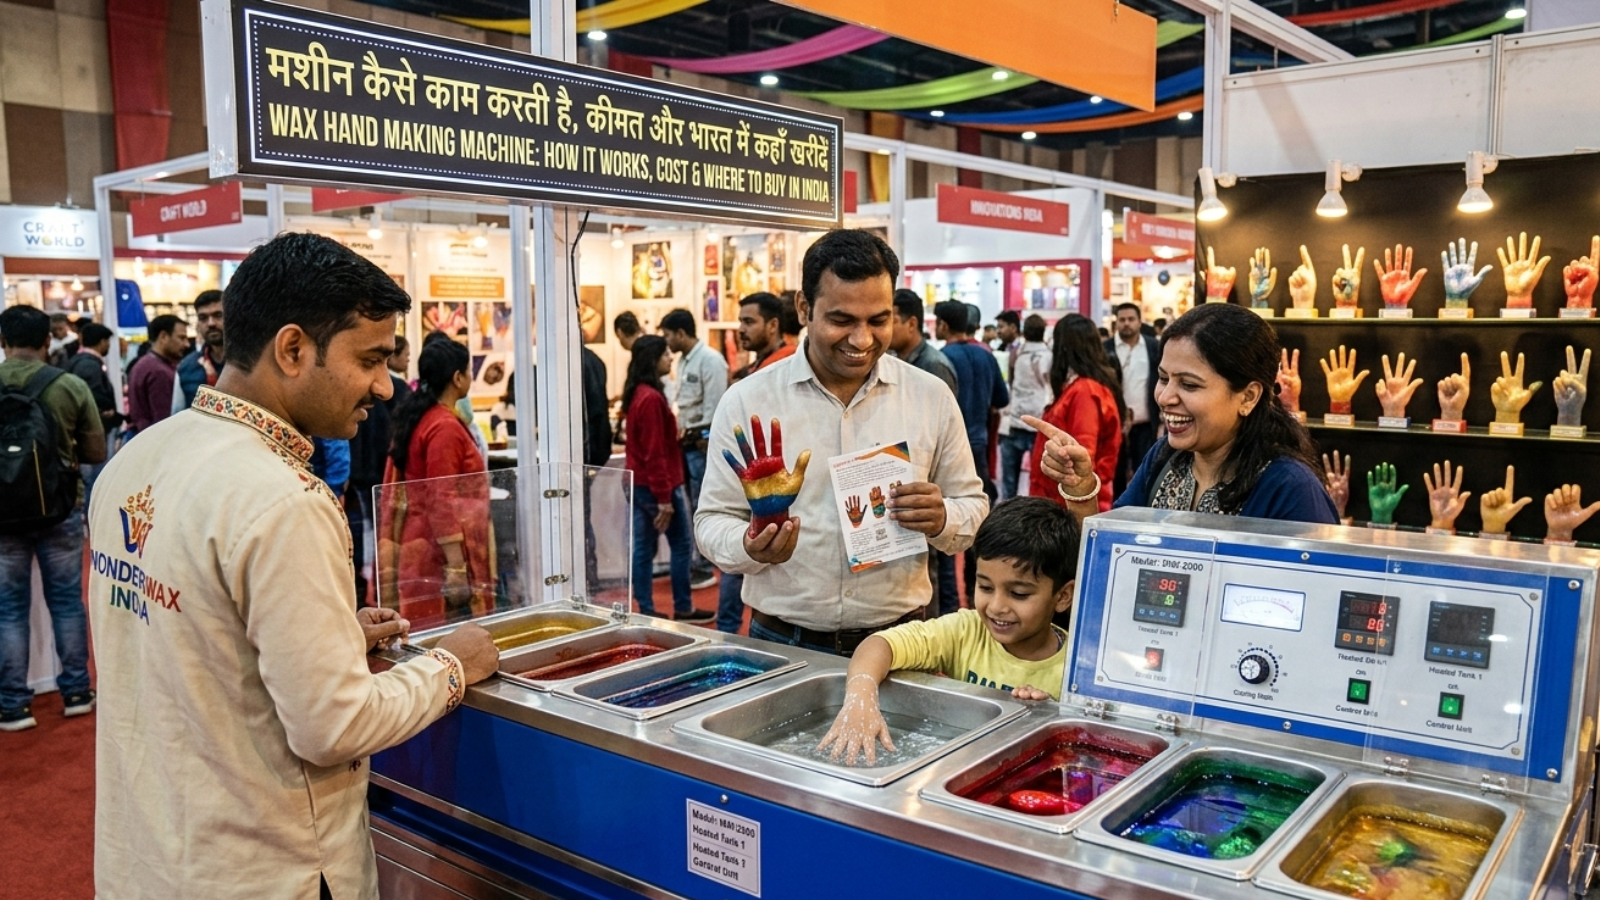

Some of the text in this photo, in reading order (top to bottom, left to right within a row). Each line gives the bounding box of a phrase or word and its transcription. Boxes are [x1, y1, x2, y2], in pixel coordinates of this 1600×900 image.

[265, 41, 829, 172] मशीन कैसे काम करती है, कीमत और भारत में कहाँ खरीदें
[268, 102, 829, 203] WAX HAND MAKING MACHINE: HOW IT WORKS, COST & WHERE TO BUY IN INDIA
